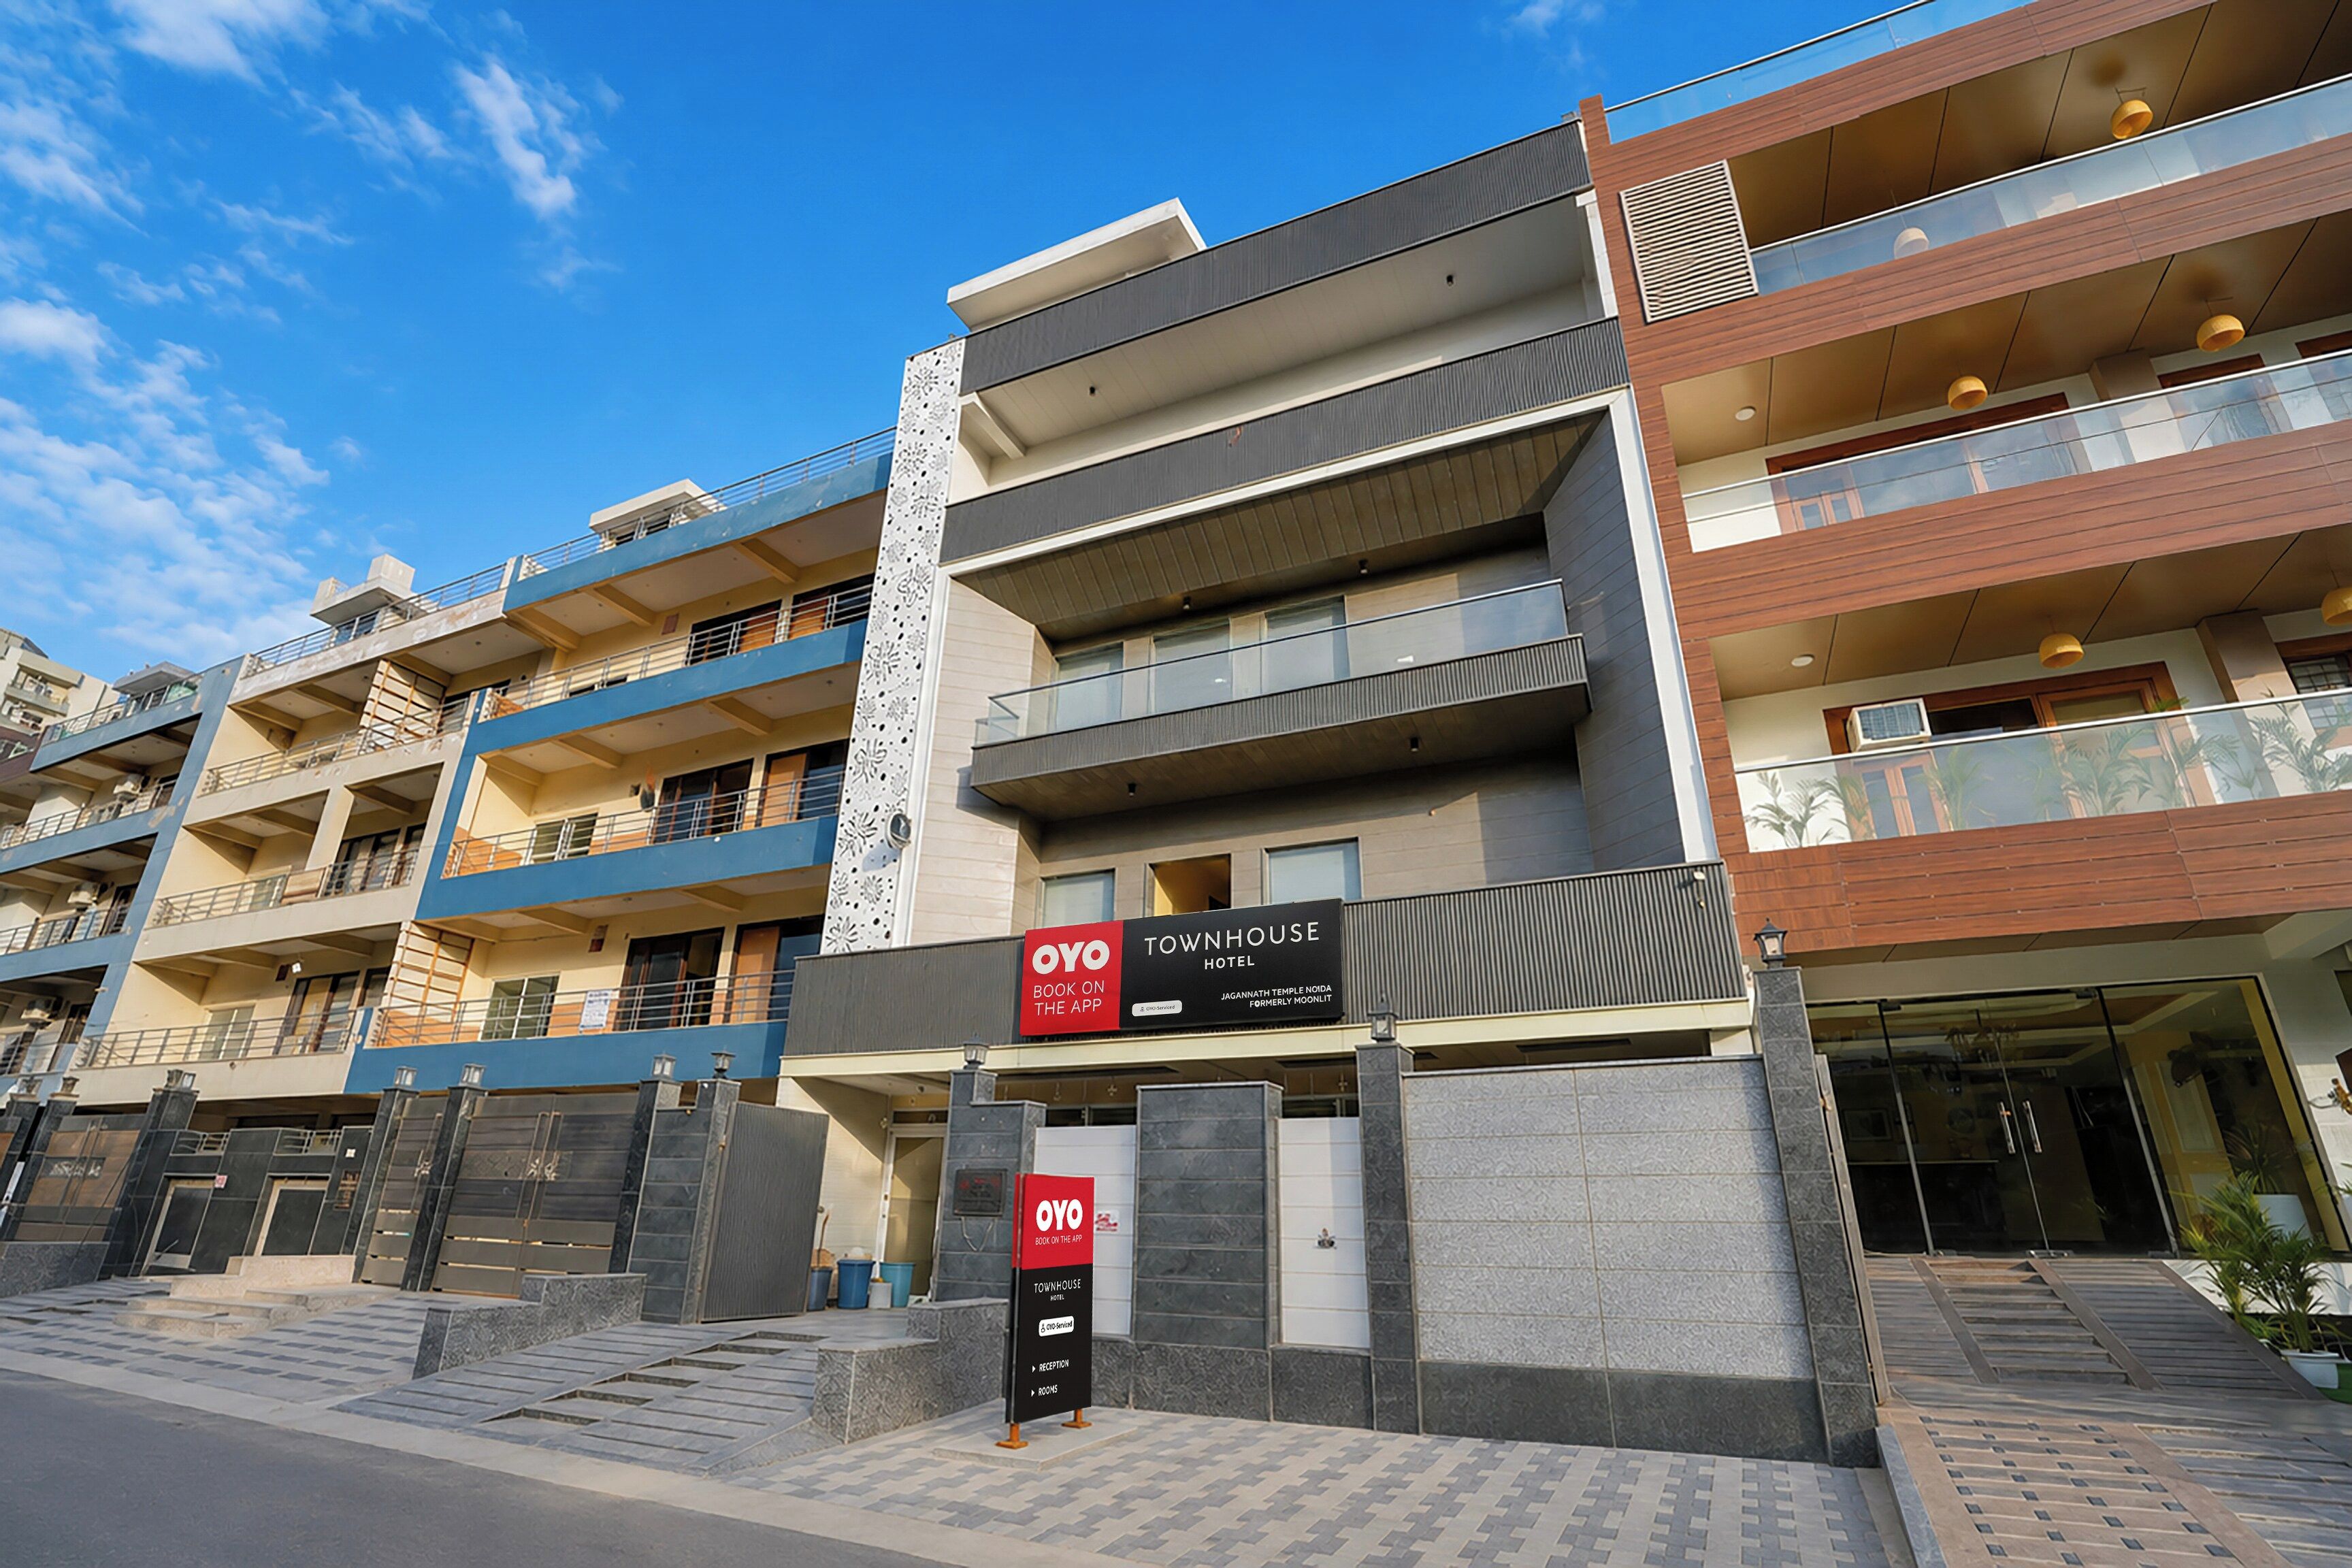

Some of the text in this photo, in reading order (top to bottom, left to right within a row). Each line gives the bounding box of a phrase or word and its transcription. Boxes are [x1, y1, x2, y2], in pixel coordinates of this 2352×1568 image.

[1144, 921, 1320, 956] TOWNHOUSE
[1032, 939, 1110, 975] OYO
[1205, 955, 1255, 970] HOTEL
[1033, 980, 1105, 998] BOOK ON
[1221, 984, 1332, 1000] JAGANNATH TEMPLE NOIDA
[1034, 998, 1102, 1016] THE APP
[1250, 994, 1333, 1008] FORMERLY MOONLIT
[1036, 1198, 1083, 1232] OYO
[1035, 1234, 1083, 1245] BOOK ON THE APP
[1034, 1279, 1081, 1294] TOWNHOUSE
[1046, 1320, 1073, 1330] OYO-Serviced
[1039, 1358, 1069, 1372] RECEPTION
[1038, 1384, 1058, 1396] ROOMS
